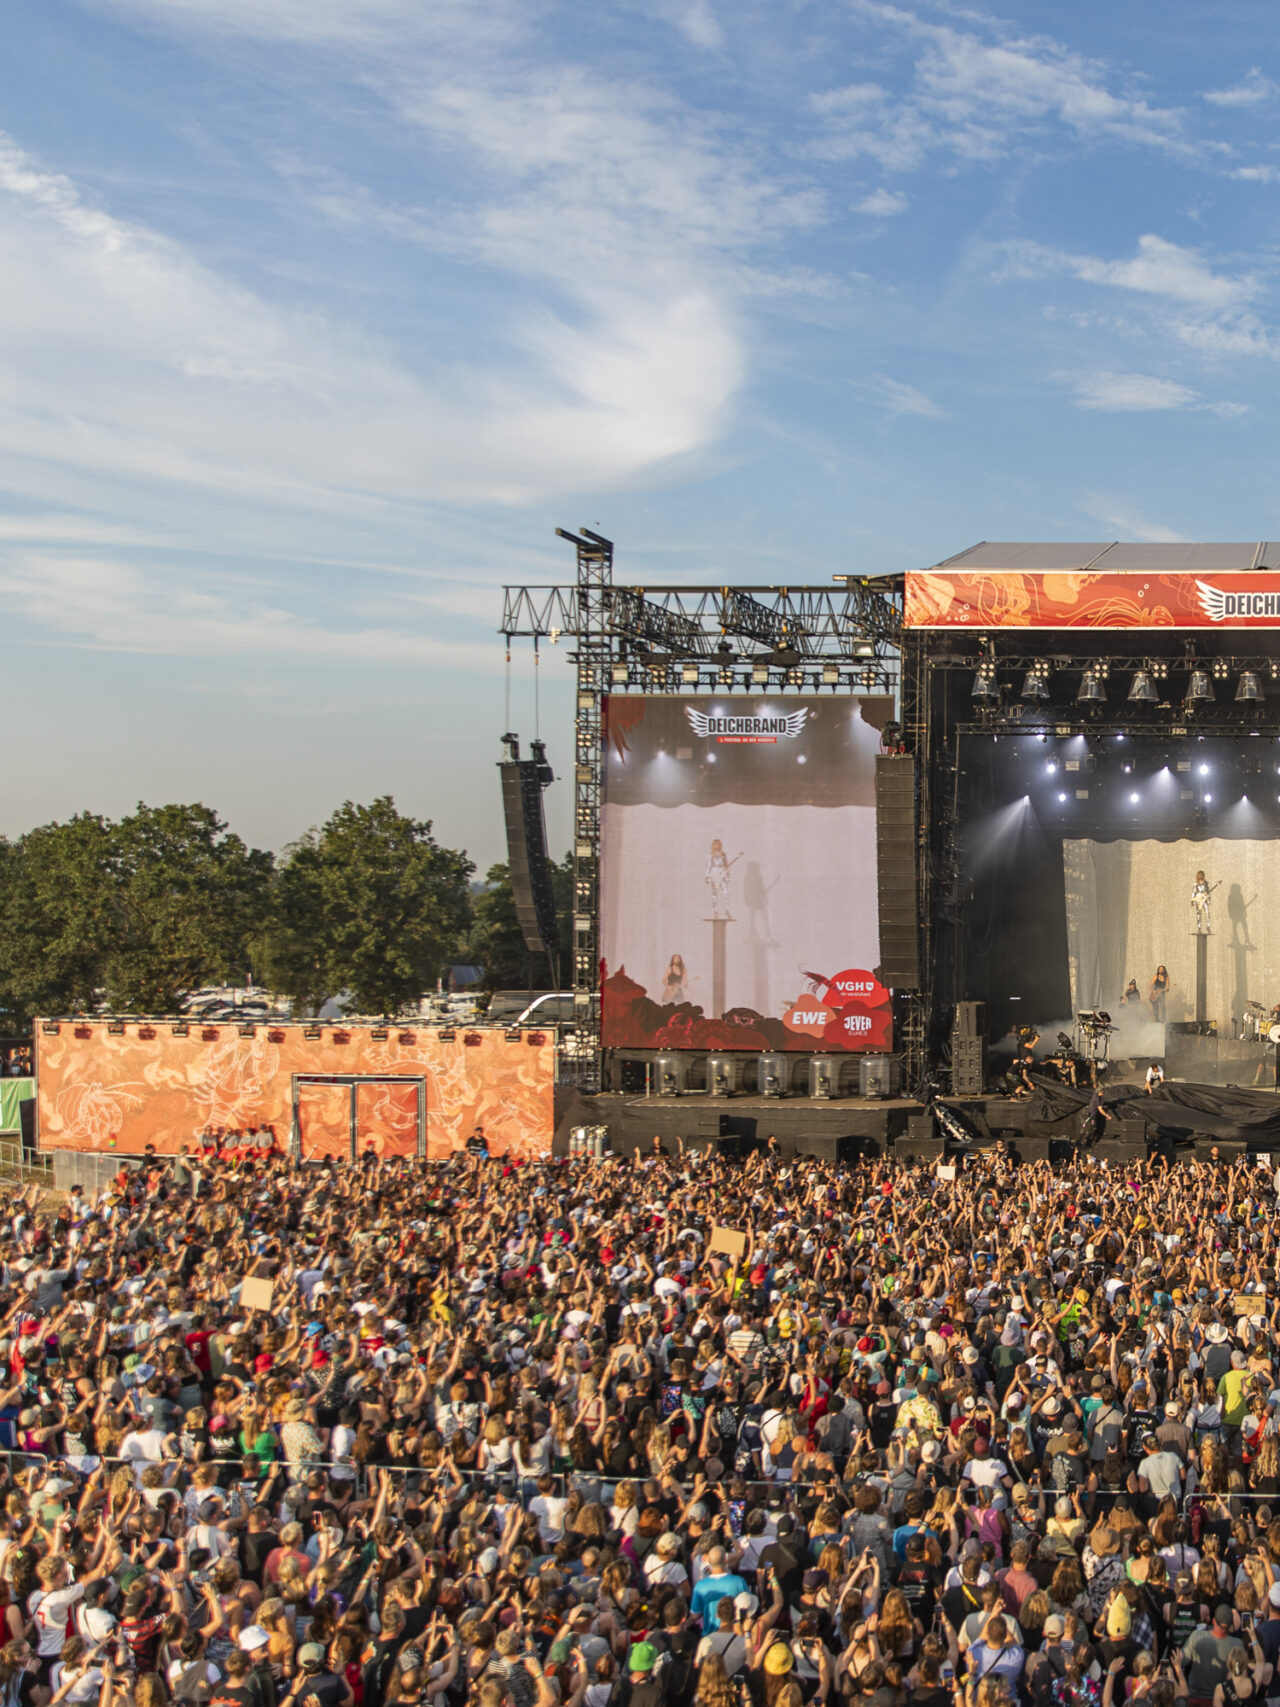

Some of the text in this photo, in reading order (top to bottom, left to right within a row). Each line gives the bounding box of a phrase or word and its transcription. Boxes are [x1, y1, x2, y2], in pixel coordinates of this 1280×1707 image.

[708, 717, 787, 734] DEICHBRAND
[836, 981, 864, 991] VGH
[792, 1012, 828, 1025] EWE
[843, 1016, 873, 1031] JEVER
